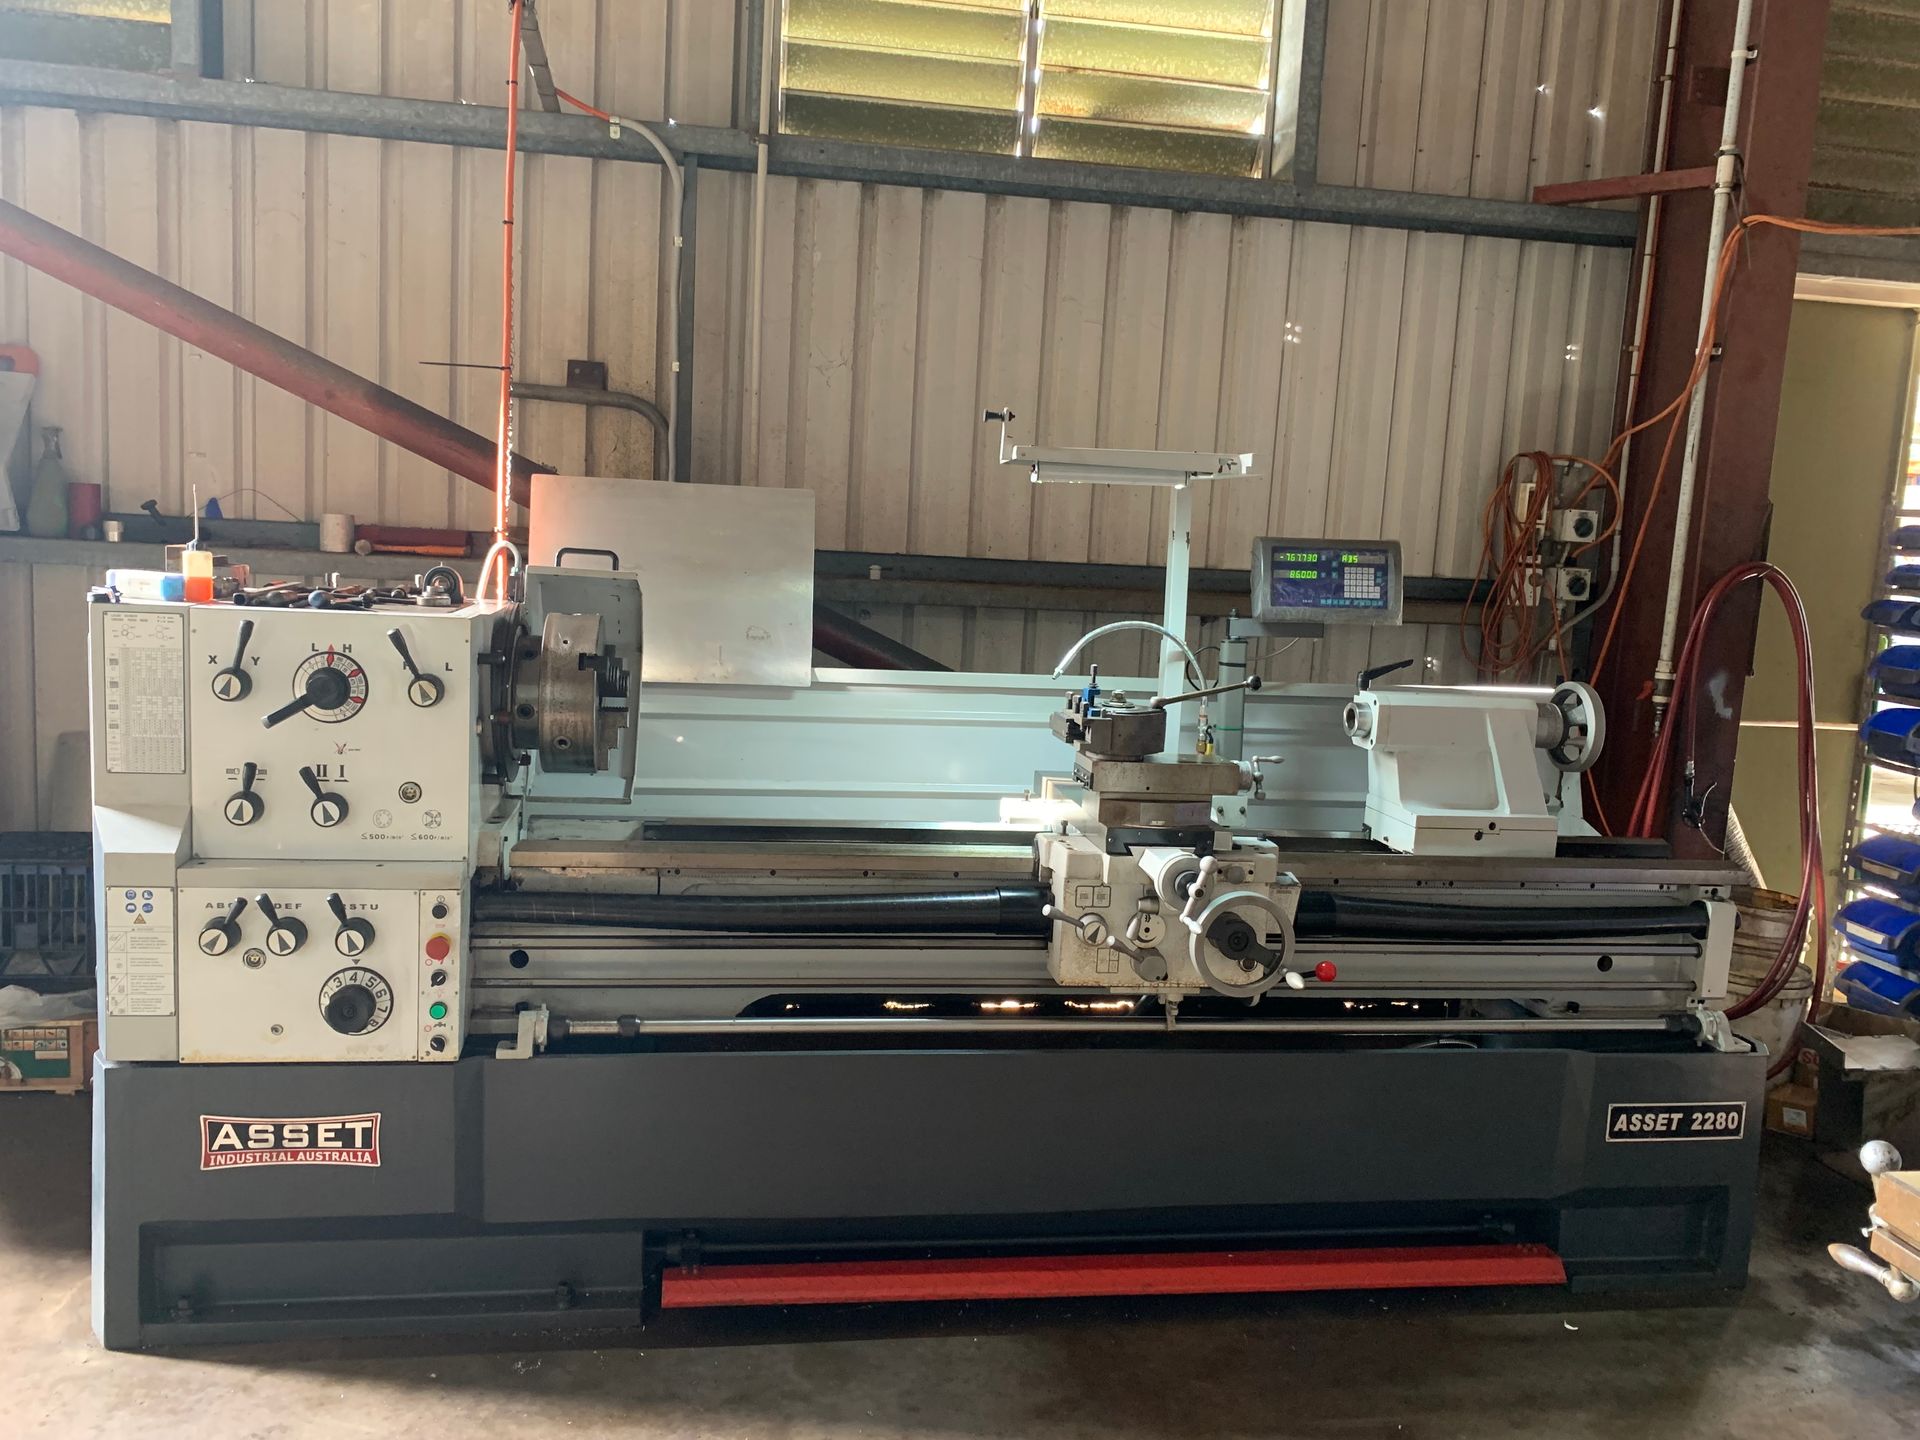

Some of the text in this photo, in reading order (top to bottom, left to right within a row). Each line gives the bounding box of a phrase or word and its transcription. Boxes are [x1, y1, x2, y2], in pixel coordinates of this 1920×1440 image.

[311, 642, 352, 653] L H
[208, 655, 261, 666] X Y
[445, 662, 453, 671] L
[333, 976, 342, 988] 3
[349, 971, 358, 983] 4
[365, 976, 377, 988] 5
[375, 988, 387, 999] 6
[1613, 1112, 1739, 1131] ASSET 2280
[211, 1121, 373, 1151] ASSET
[209, 1151, 372, 1166] INDUSTRIAL AUSTRALIA
